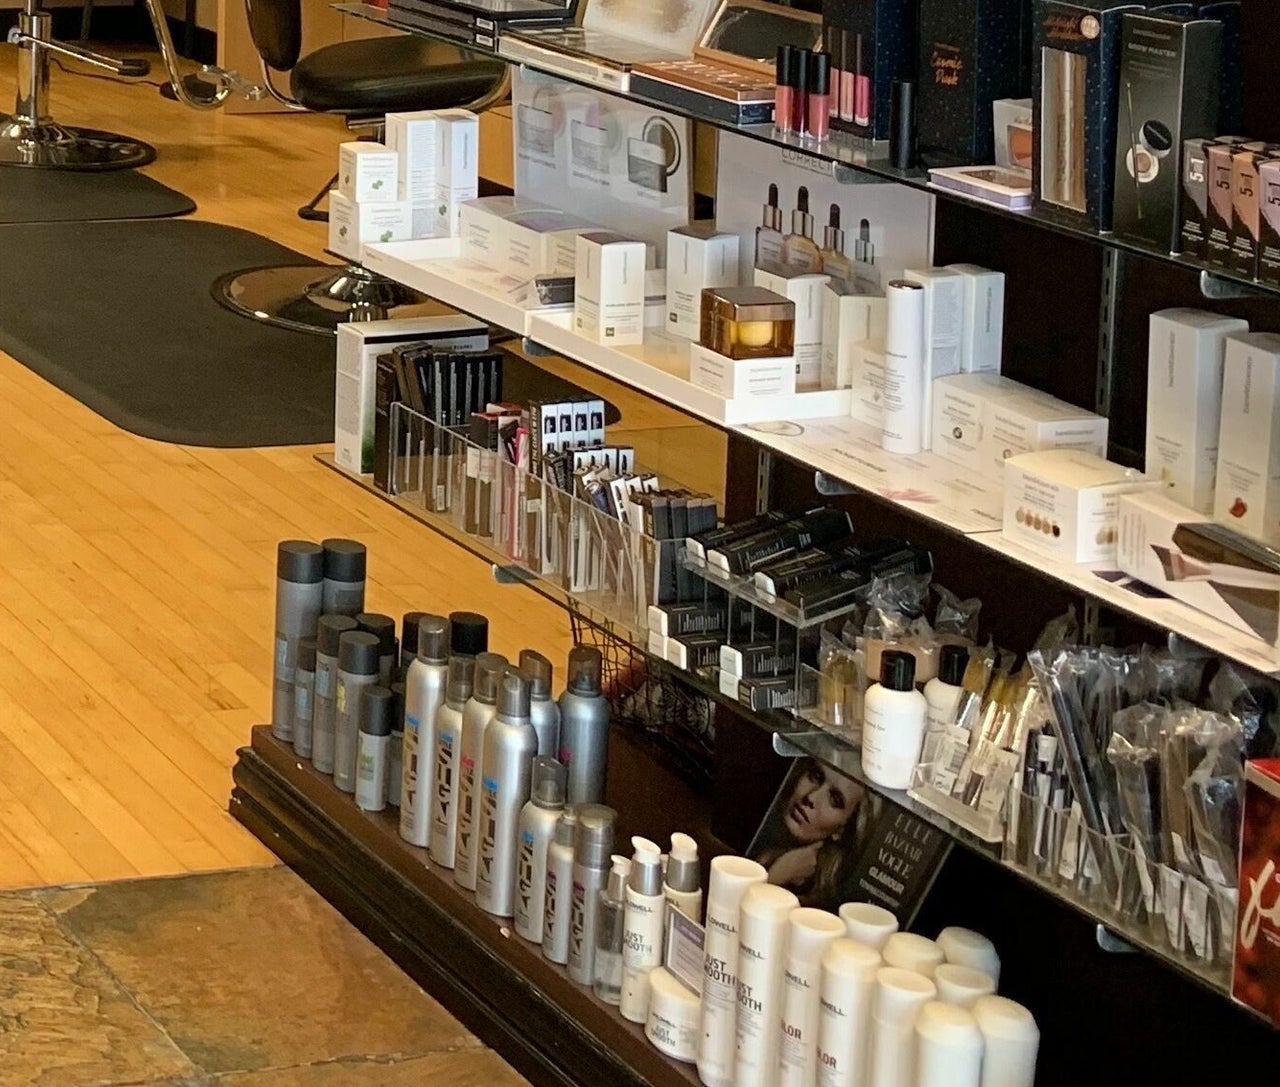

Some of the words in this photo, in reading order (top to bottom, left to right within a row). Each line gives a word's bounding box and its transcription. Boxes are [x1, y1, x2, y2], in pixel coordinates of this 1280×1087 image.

[1148, 45, 1177, 59] MASTER
[895, 813, 932, 844] ELLE
[879, 847, 913, 880] VOGUE
[868, 866, 905, 896] GLAMOUR
